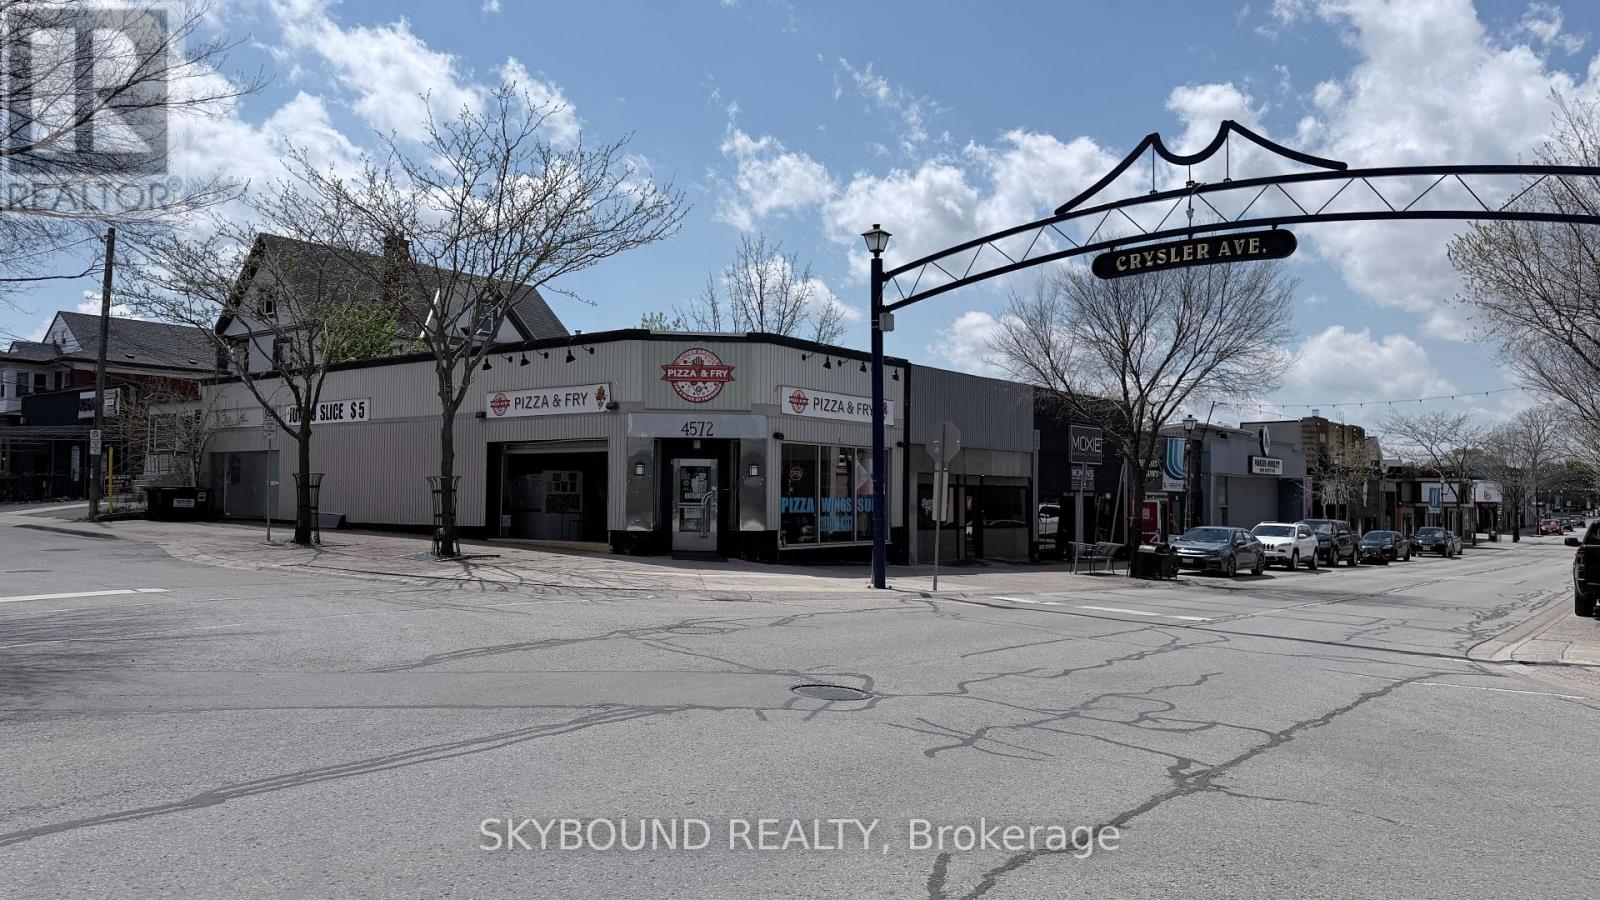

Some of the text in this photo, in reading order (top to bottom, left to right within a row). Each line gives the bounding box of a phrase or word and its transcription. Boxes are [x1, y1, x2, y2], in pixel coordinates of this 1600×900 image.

[1116, 237, 1268, 272] CRYSLER AVE.
[667, 369, 729, 378] PIZZA & FRY
[514, 394, 549, 411] PIZZA
[552, 393, 561, 408] &
[565, 391, 588, 407] FRY
[813, 397, 845, 413] PIZZA
[846, 401, 855, 415] &
[320, 402, 344, 421] SLICE
[681, 421, 714, 437] 4572
[1072, 434, 1101, 453] MOXIE
[781, 496, 815, 513] PIZZA
[821, 496, 852, 513] WINGS
[857, 497, 873, 513] SU
